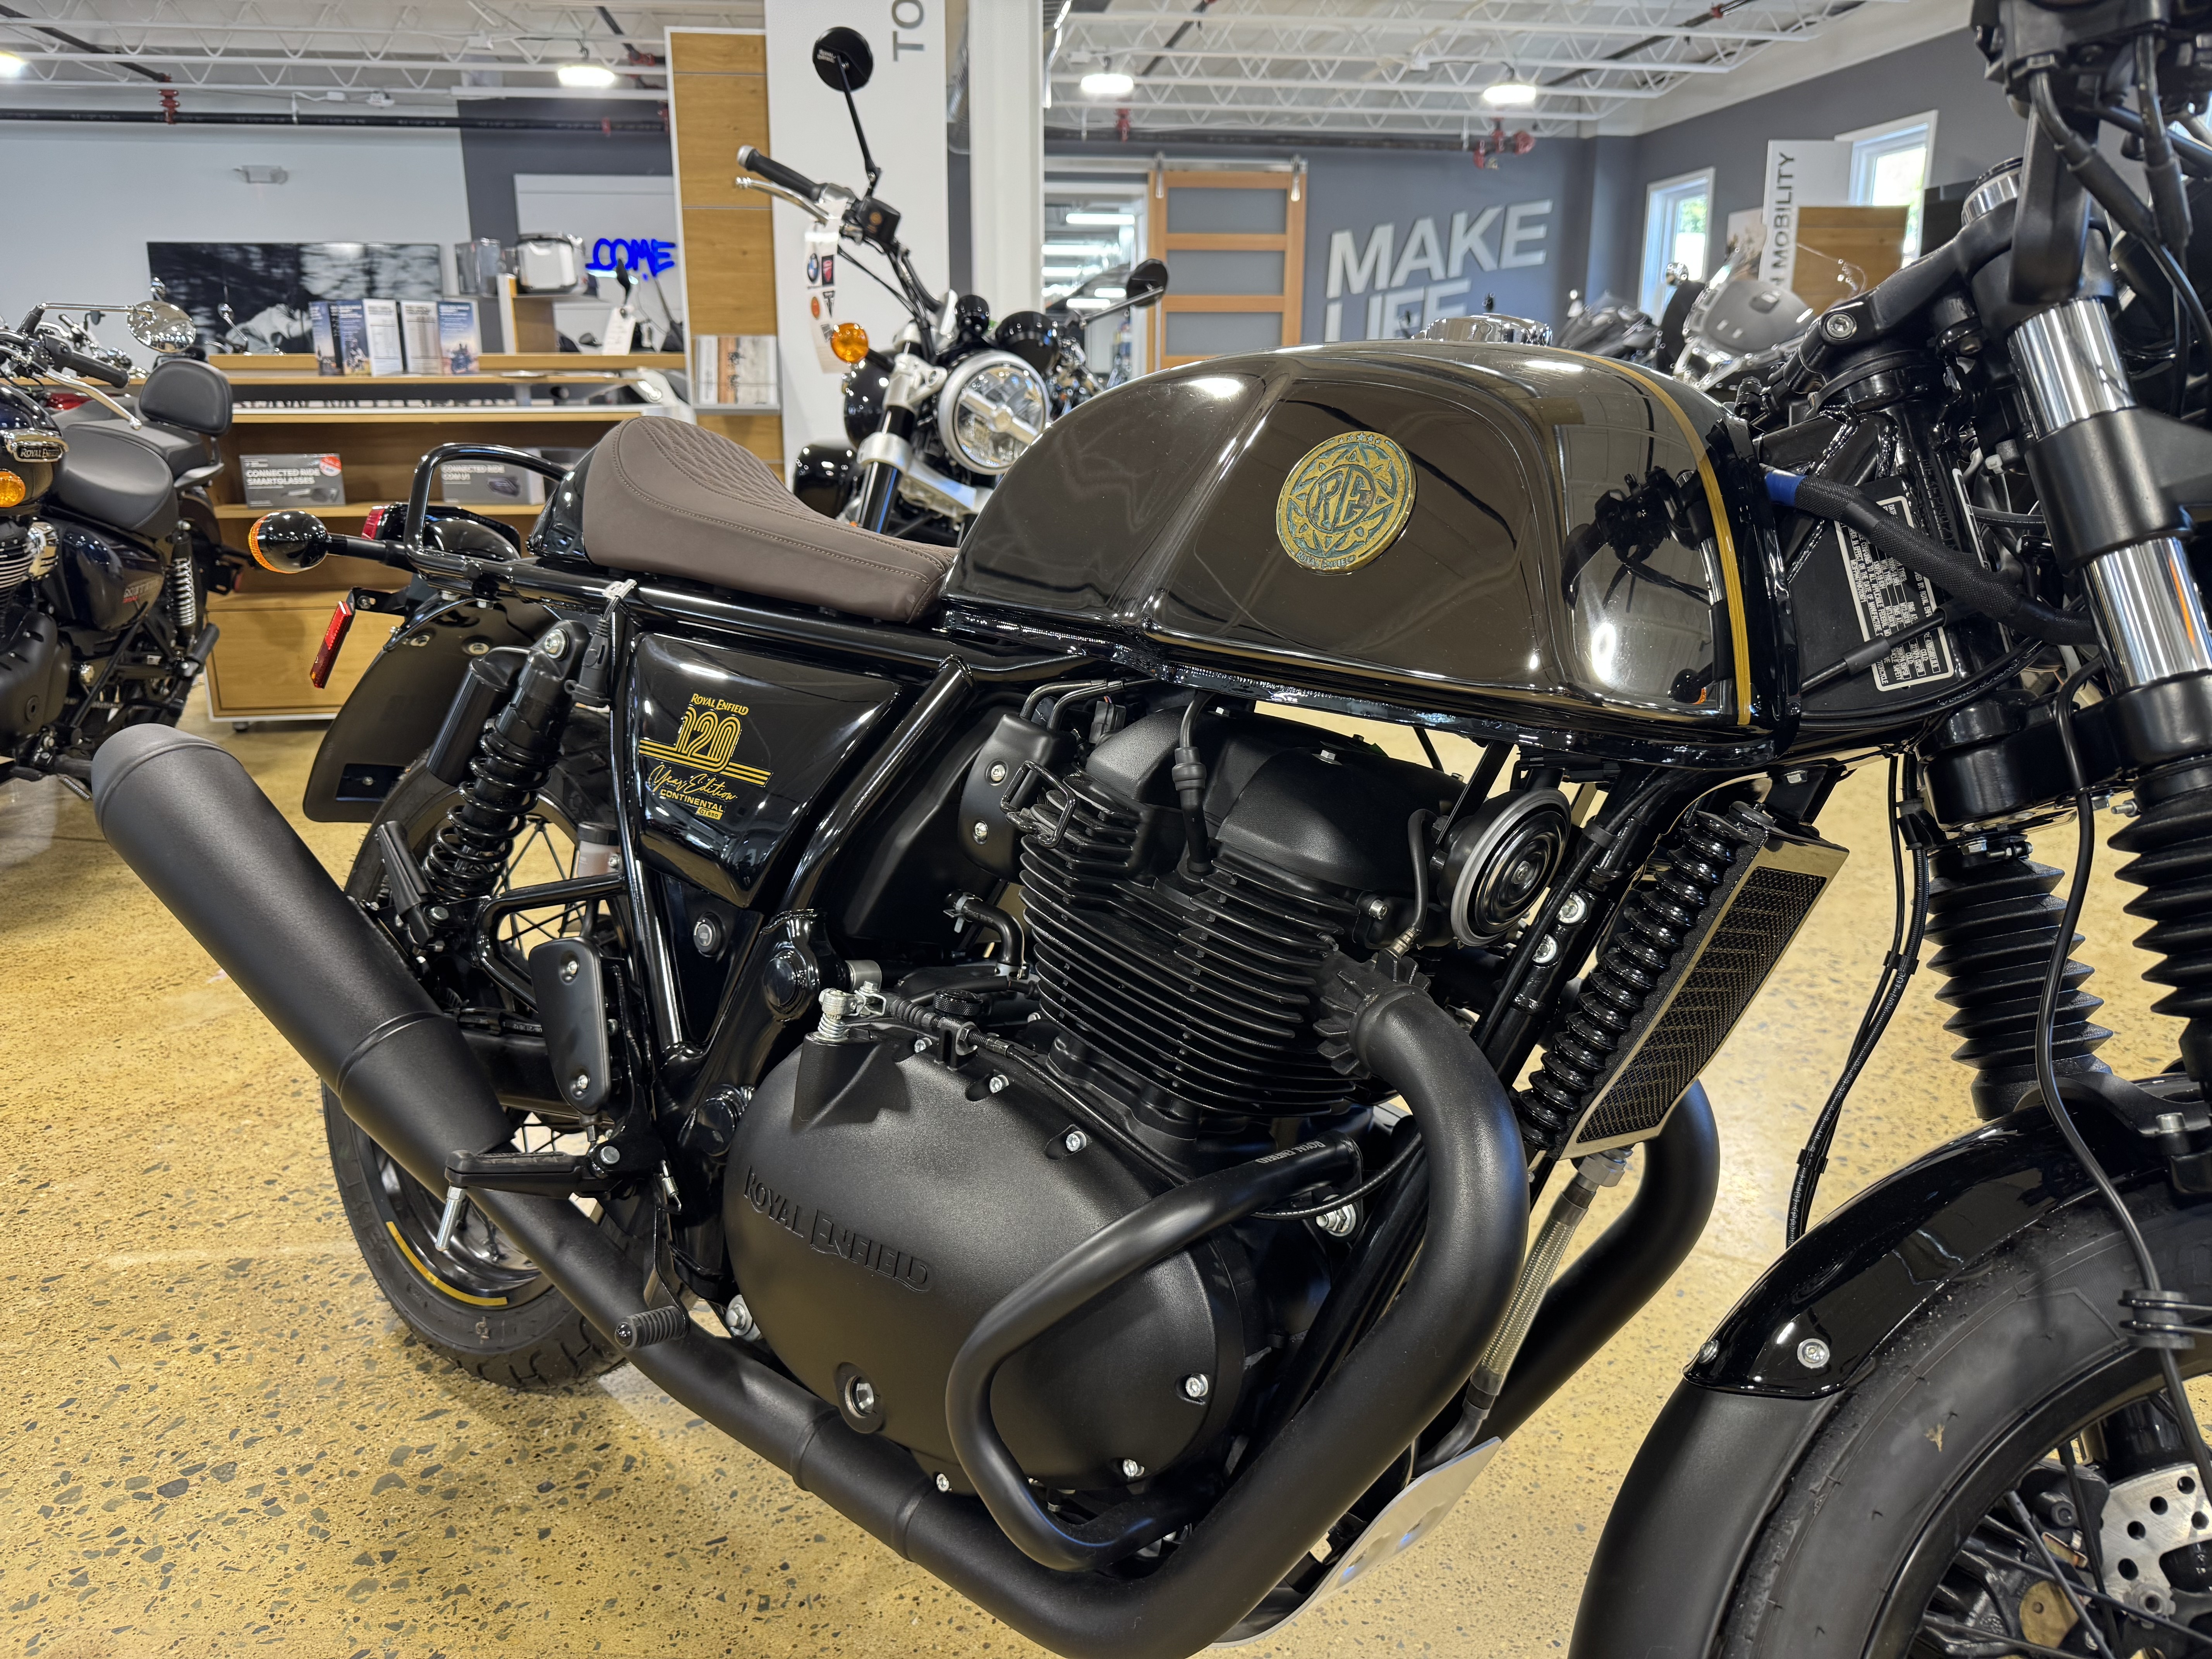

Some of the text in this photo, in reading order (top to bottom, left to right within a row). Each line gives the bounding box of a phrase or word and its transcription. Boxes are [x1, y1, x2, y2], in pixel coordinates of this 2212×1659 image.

[891, 0, 924, 61] TO
[1771, 152, 1795, 269] MOBILITY
[1326, 199, 1553, 299] MAKE
[21, 447, 41, 458] ROYAL
[246, 468, 321, 477] CONNECTED RIDE
[246, 476, 315, 485] SMARTGLASSES
[1296, 551, 1356, 568] ROYAL ENFIELD
[1854, 546, 1863, 561] EFFECT
[1863, 581, 1872, 592] DATE
[1868, 601, 1882, 632] MANUFACTURE
[1920, 591, 1929, 605] ROYAL
[1860, 542, 1871, 564] CONFORMS
[1871, 583, 1883, 608] APPLICABLE
[1878, 609, 1888, 628] FEDERAL
[1893, 664, 1903, 680] SAFETY
[691, 694, 749, 716] ROYAL ENFIELD
[677, 706, 741, 772] 120
[649, 765, 737, 800] Year Edition
[660, 789, 723, 812] CONTINENTAL
[1255, 1141, 1326, 1163] ROYAL ENFIELD
[744, 1166, 932, 1293] ROYAL ENFIELD
